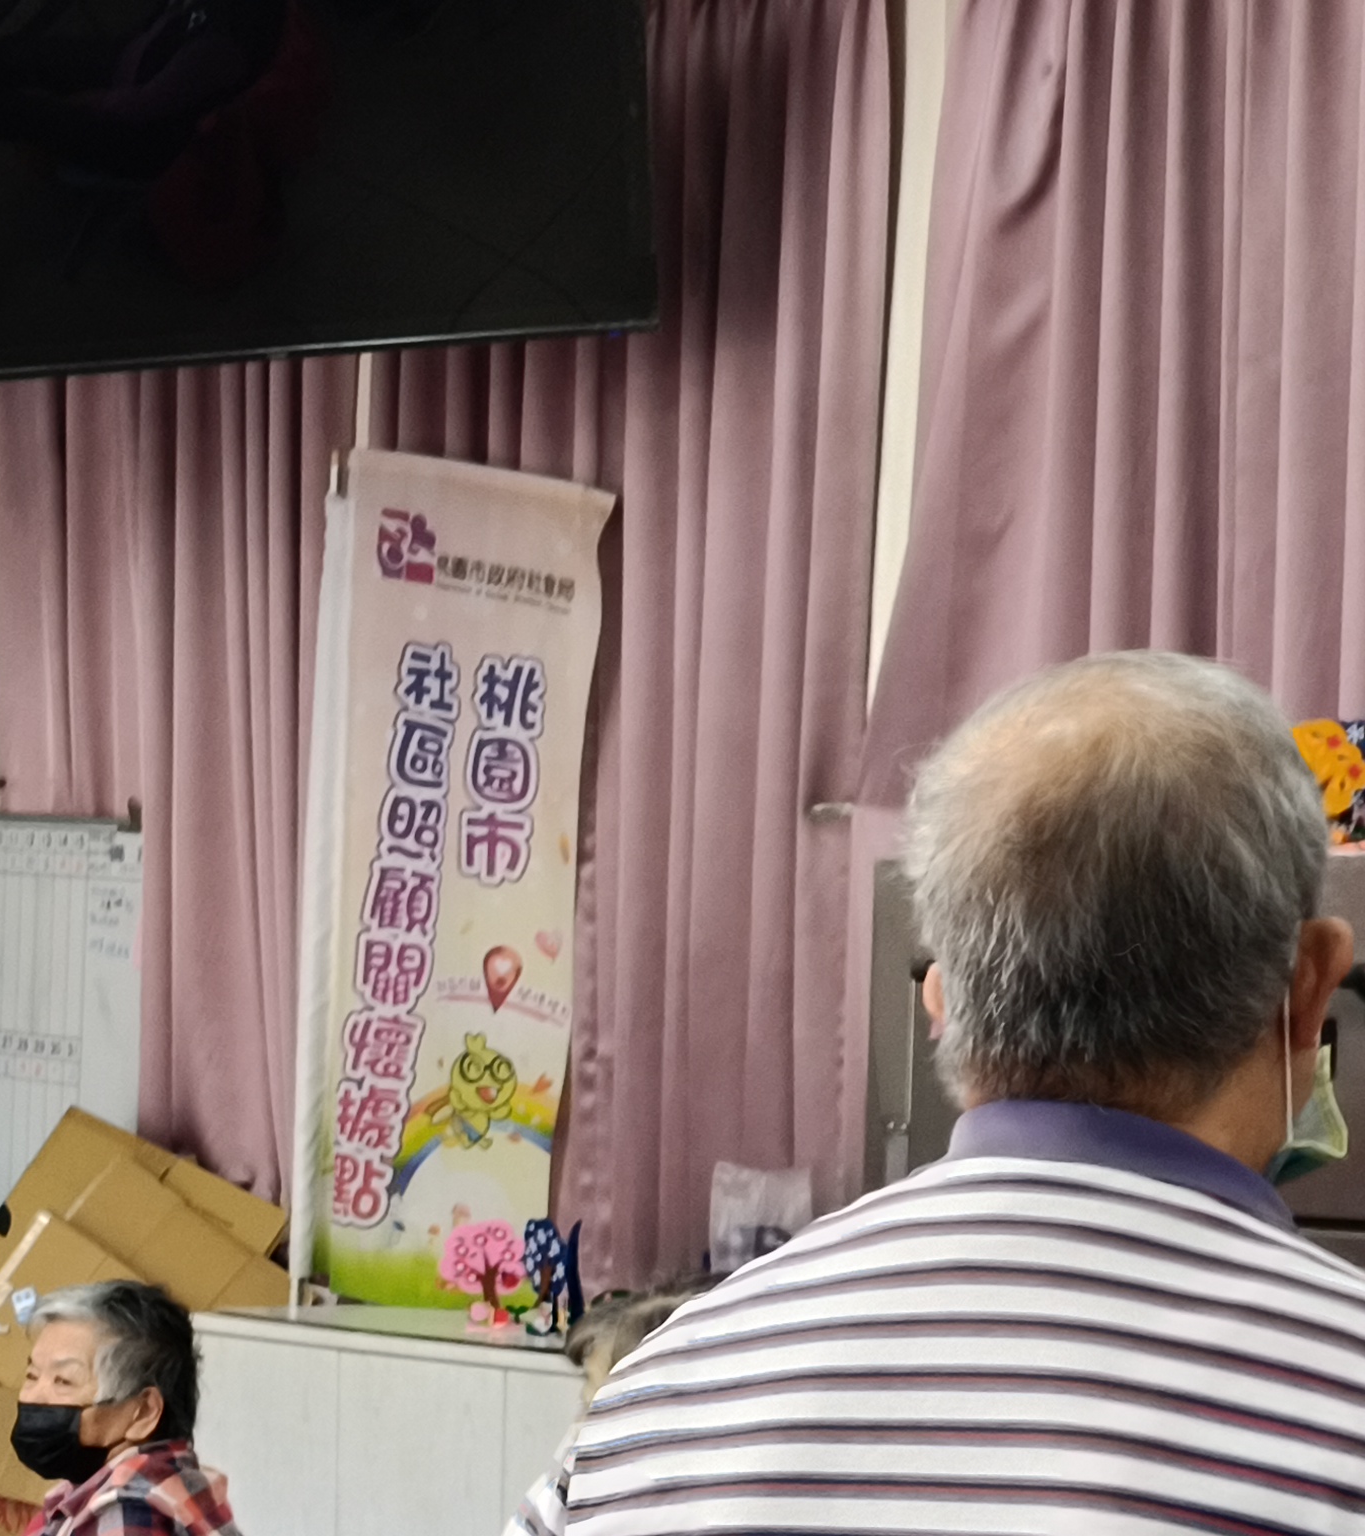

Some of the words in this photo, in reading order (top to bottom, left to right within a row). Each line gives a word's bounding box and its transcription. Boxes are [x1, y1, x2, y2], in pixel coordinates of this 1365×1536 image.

[333, 652, 455, 1220] 社區照顧關懷據點
[466, 662, 544, 878] 桃園市
